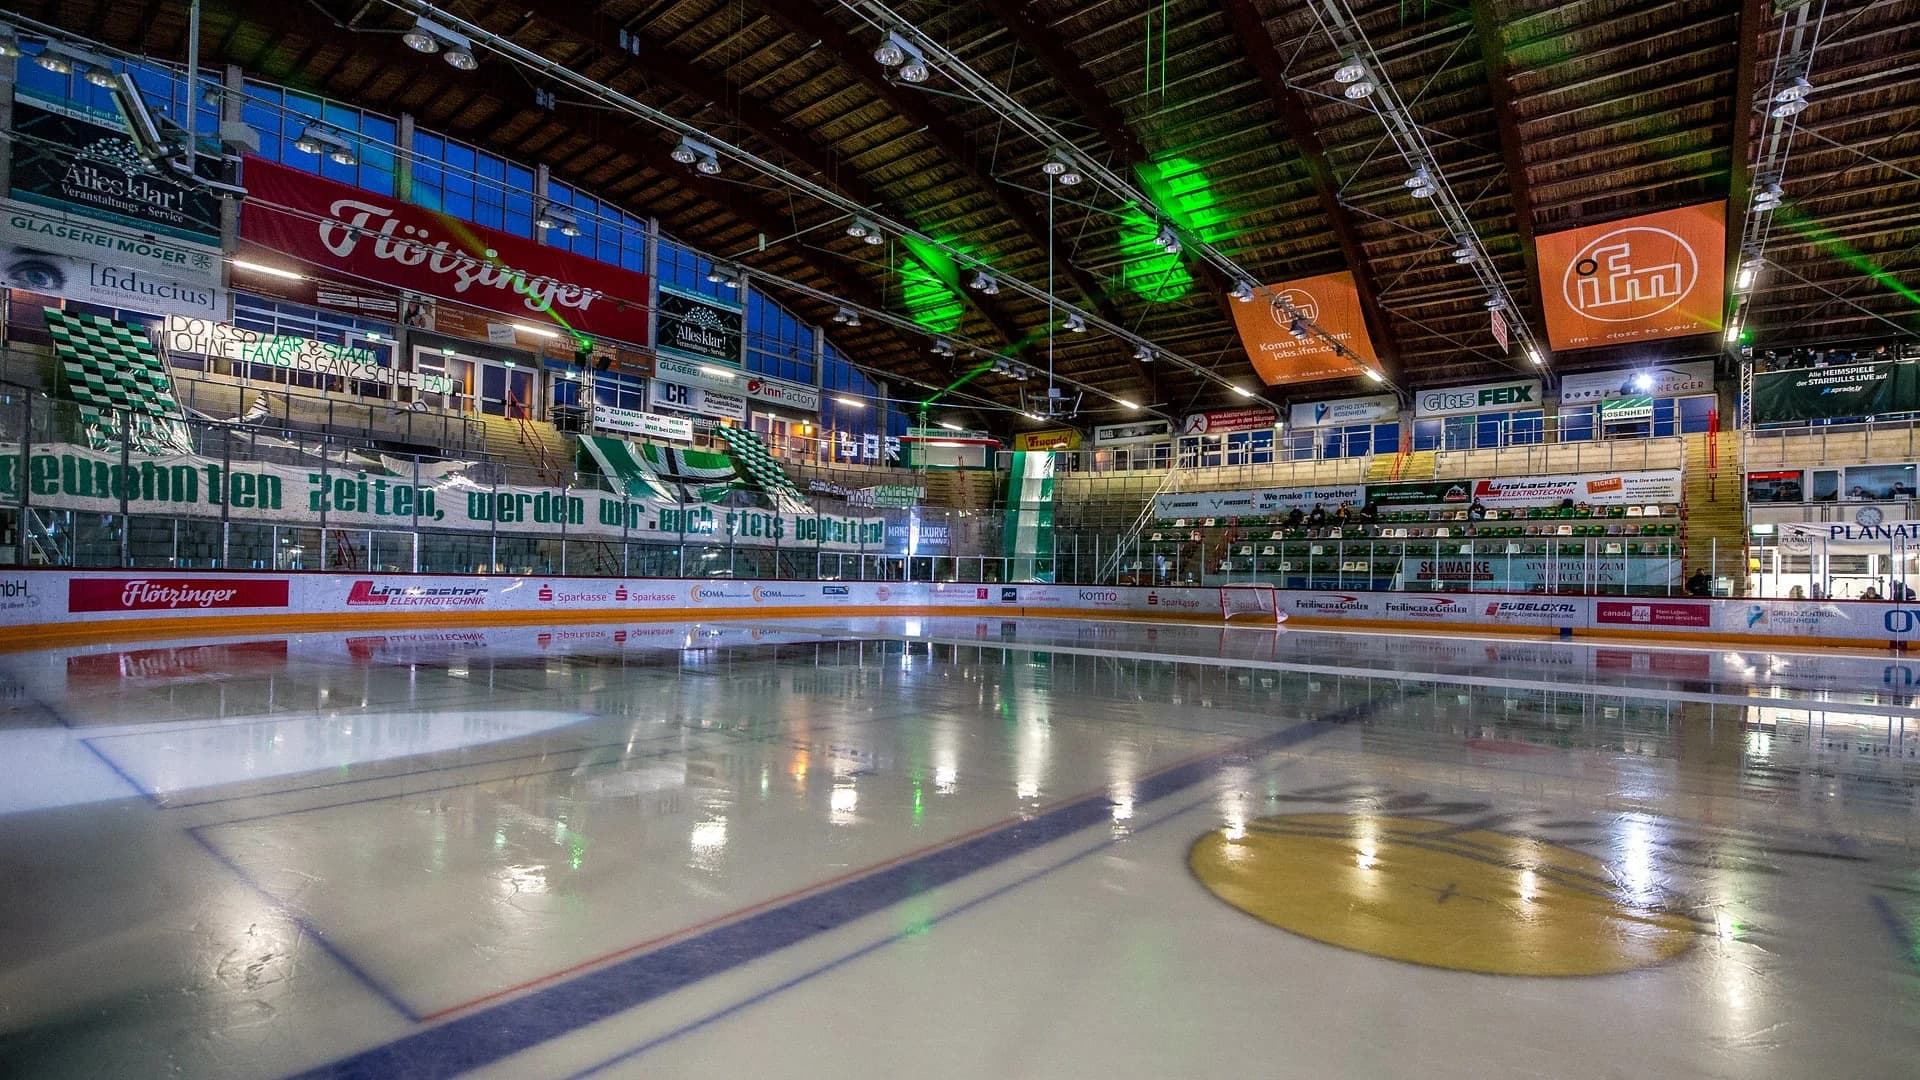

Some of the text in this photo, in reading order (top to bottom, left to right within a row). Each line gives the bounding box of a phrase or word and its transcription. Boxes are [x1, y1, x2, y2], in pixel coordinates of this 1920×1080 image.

[61, 163, 184, 212] Alles klar!
[147, 206, 184, 224] Service
[10, 215, 113, 248] GLASEREI
[318, 199, 603, 312] Flötzinger
[676, 325, 727, 350] Alles klar!
[1606, 330, 1640, 339] close
[1644, 327, 1659, 335] to
[308, 341, 321, 356] &
[1259, 339, 1296, 352] Komm
[1317, 332, 1352, 344] Tam:
[173, 332, 234, 355] OHNE
[241, 342, 293, 368] FANS
[1273, 343, 1339, 361] jobs.ifm.co
[659, 361, 700, 377] GLASEREI
[1822, 366, 1875, 377] HEIMSPIELE
[1808, 375, 1855, 386] STARBULLS
[1856, 373, 1875, 381] LIVE
[665, 382, 688, 405] CR
[763, 385, 817, 409] innFactory
[1423, 385, 1533, 411] Glas FEIX
[1593, 479, 1618, 487] TICKET
[1263, 493, 1278, 501] We
[1279, 492, 1303, 500] make
[1314, 489, 1357, 500] together!
[1501, 488, 1576, 497] ELEKTROTECHNIK
[0, 454, 282, 510] gewohnten
[309, 471, 446, 522] Zeiten,
[467, 490, 585, 525] werden
[599, 498, 645, 529] wir
[725, 508, 784, 539] stets
[795, 516, 884, 546] begleiten!
[121, 580, 237, 608] Flötzinger
[390, 596, 486, 606] ELEKTROTECHNIK
[558, 591, 607, 603] Sparkasse
[632, 592, 676, 603] Sparkasse
[699, 590, 724, 599] ISOMA
[759, 590, 782, 599] ISOMA
[1002, 590, 1016, 598] ACP
[1079, 589, 1117, 602] komro
[1161, 597, 1200, 608] Sparkasse
[1603, 609, 1631, 617] canada
